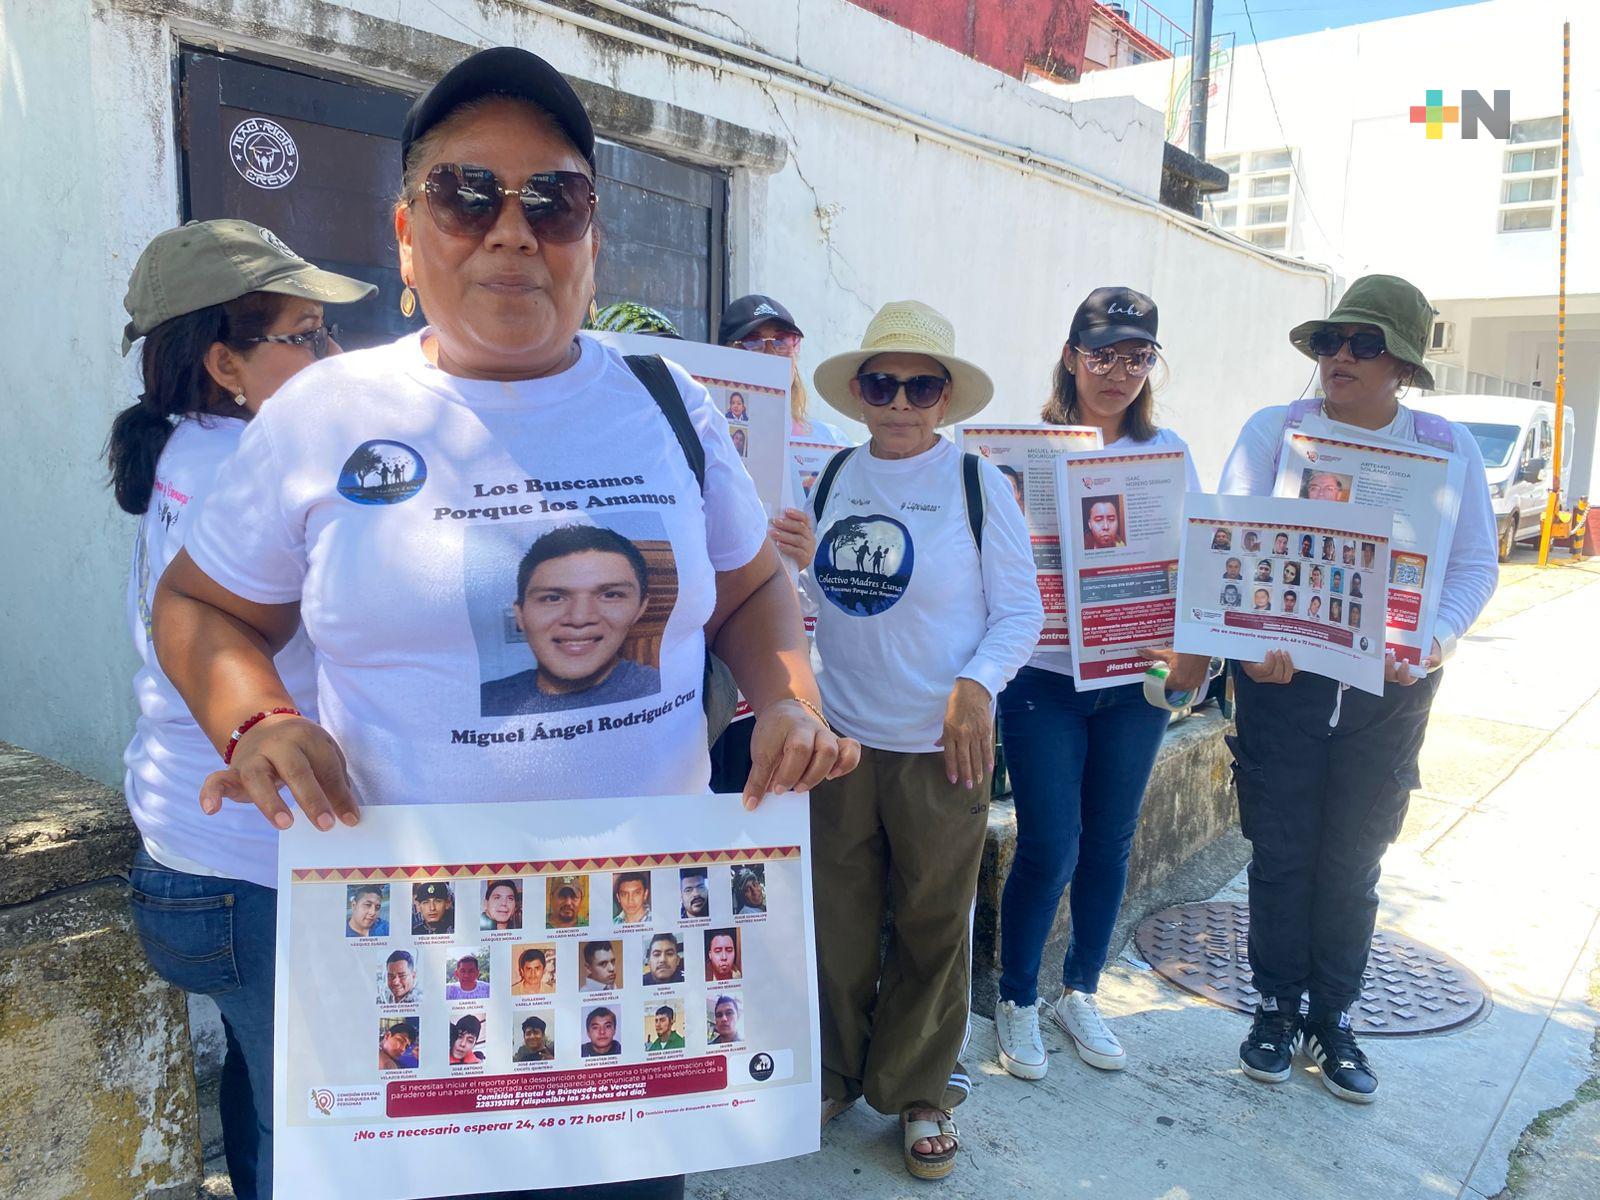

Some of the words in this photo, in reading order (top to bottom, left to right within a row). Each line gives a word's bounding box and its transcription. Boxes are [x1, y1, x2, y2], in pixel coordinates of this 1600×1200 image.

[1360, 462, 1391, 470] ARTEMIO
[473, 483, 519, 498] Los
[525, 473, 645, 494] Buscamos
[432, 502, 533, 521] Porque
[540, 499, 578, 513] los
[585, 492, 676, 509] Amamos
[818, 573, 849, 585] Colectivo
[849, 577, 880, 588] Madres
[880, 581, 903, 592] Luna
[1106, 661, 1133, 673] ¡Hasta
[450, 726, 525, 748] Miguel
[530, 722, 593, 740] Ángel
[598, 701, 673, 732] Rodriguéz
[674, 689, 697, 708] Cruz
[408, 1083, 444, 1091] necesitas
[445, 1081, 469, 1090] iniciar
[478, 1079, 506, 1088] reporte
[507, 1078, 520, 1087] por
[529, 1073, 577, 1084] desaparición
[577, 1072, 587, 1080] de
[603, 1069, 633, 1078] persona
[639, 1066, 662, 1074] tienes
[662, 1060, 704, 1072] información
[704, 1059, 715, 1067] del
[391, 1091, 425, 1100] paradero
[454, 1088, 484, 1098] persona
[485, 1085, 523, 1095] reportada
[546, 1079, 596, 1090] desaparecida,
[475, 1099, 520, 1108] 2283193187
[520, 1096, 565, 1107] (disponible
[592, 1091, 615, 1099] horas
[617, 1090, 629, 1098] del
[629, 1088, 647, 1097] día).
[476, 1092, 514, 1101] Comisión
[515, 1090, 544, 1099] Estatal
[557, 1086, 597, 1096] Búsqueda
[598, 1085, 609, 1093] de
[610, 1082, 647, 1091] Veracruz:
[353, 1130, 376, 1142] ¡No
[379, 1130, 394, 1139] es
[397, 1123, 460, 1138] necesario
[463, 1122, 513, 1134] esperar
[515, 1119, 535, 1130] 24,
[538, 1117, 555, 1127] 48
[557, 1118, 566, 1126] o
[569, 1115, 584, 1125] 72
[586, 1110, 626, 1124] horas!
